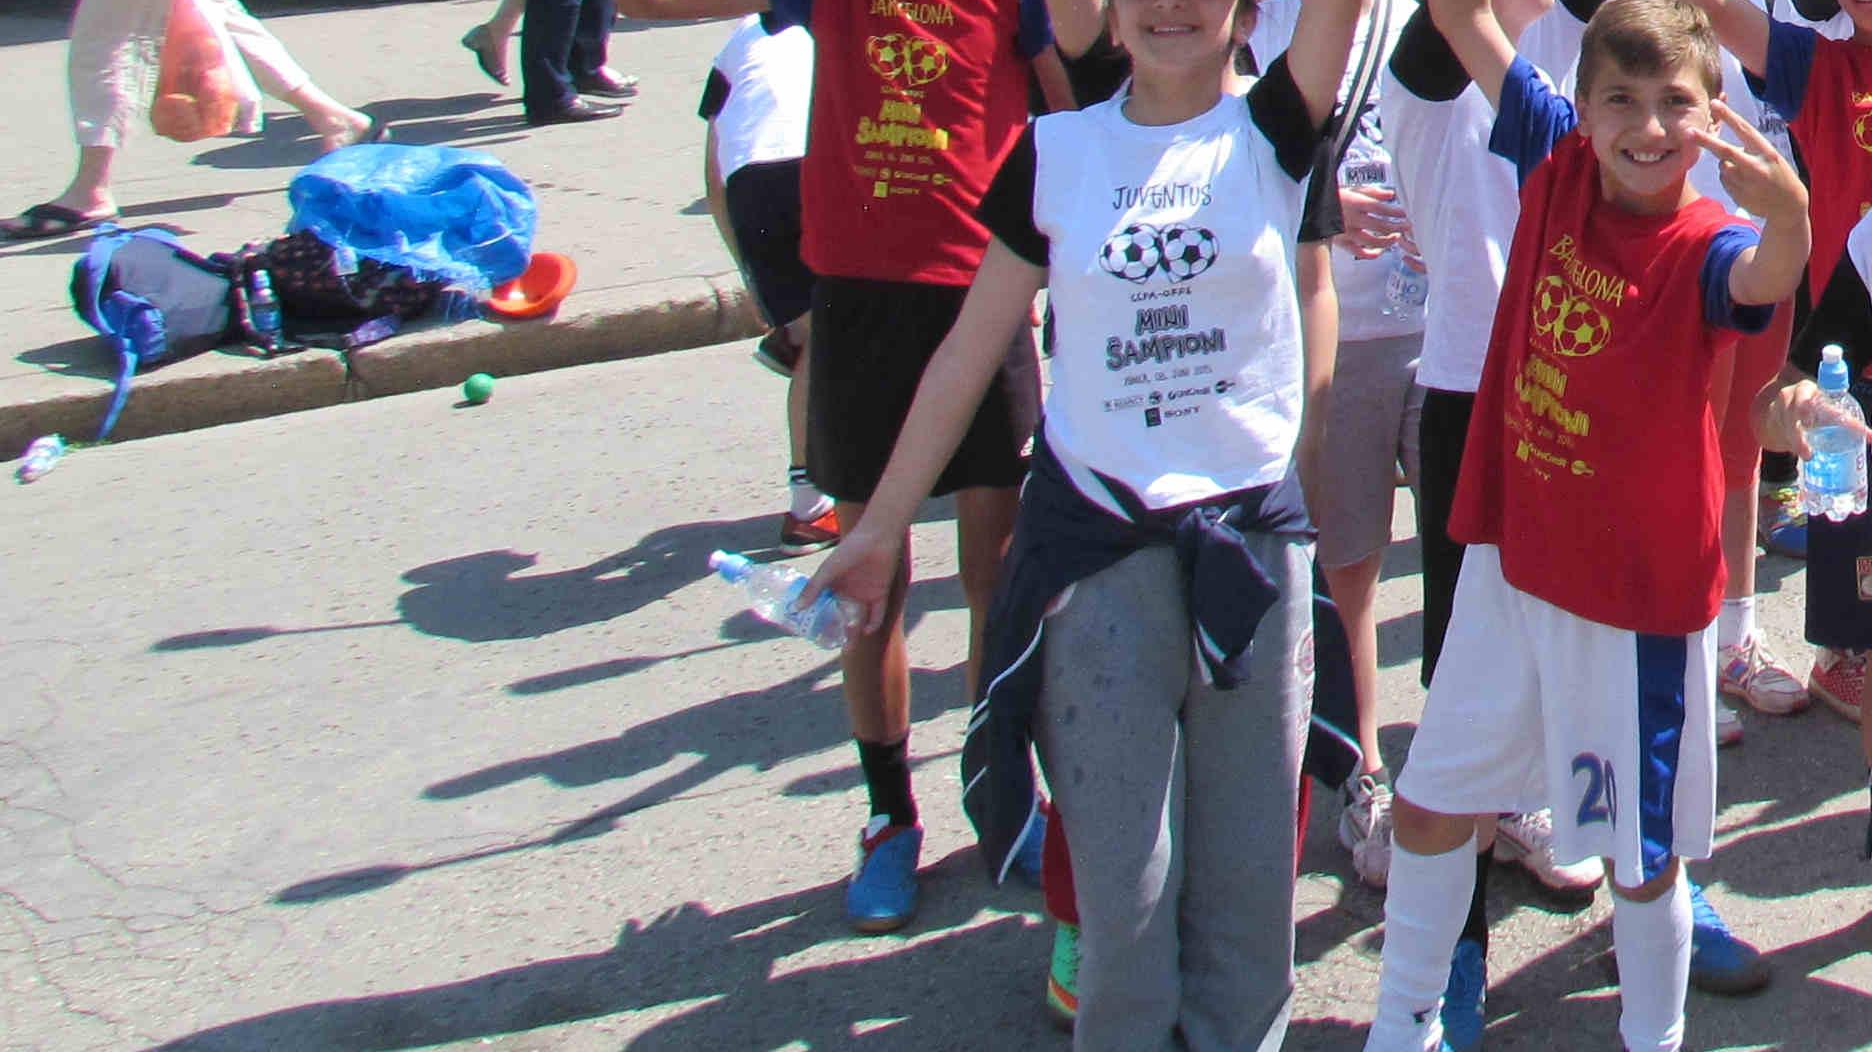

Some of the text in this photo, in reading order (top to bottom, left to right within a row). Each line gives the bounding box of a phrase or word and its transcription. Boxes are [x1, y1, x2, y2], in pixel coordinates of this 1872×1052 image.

[1112, 183, 1212, 210] JUVENTUS
[1135, 304, 1190, 336] MINI
[1106, 327, 1227, 372] ŠAMPIONI
